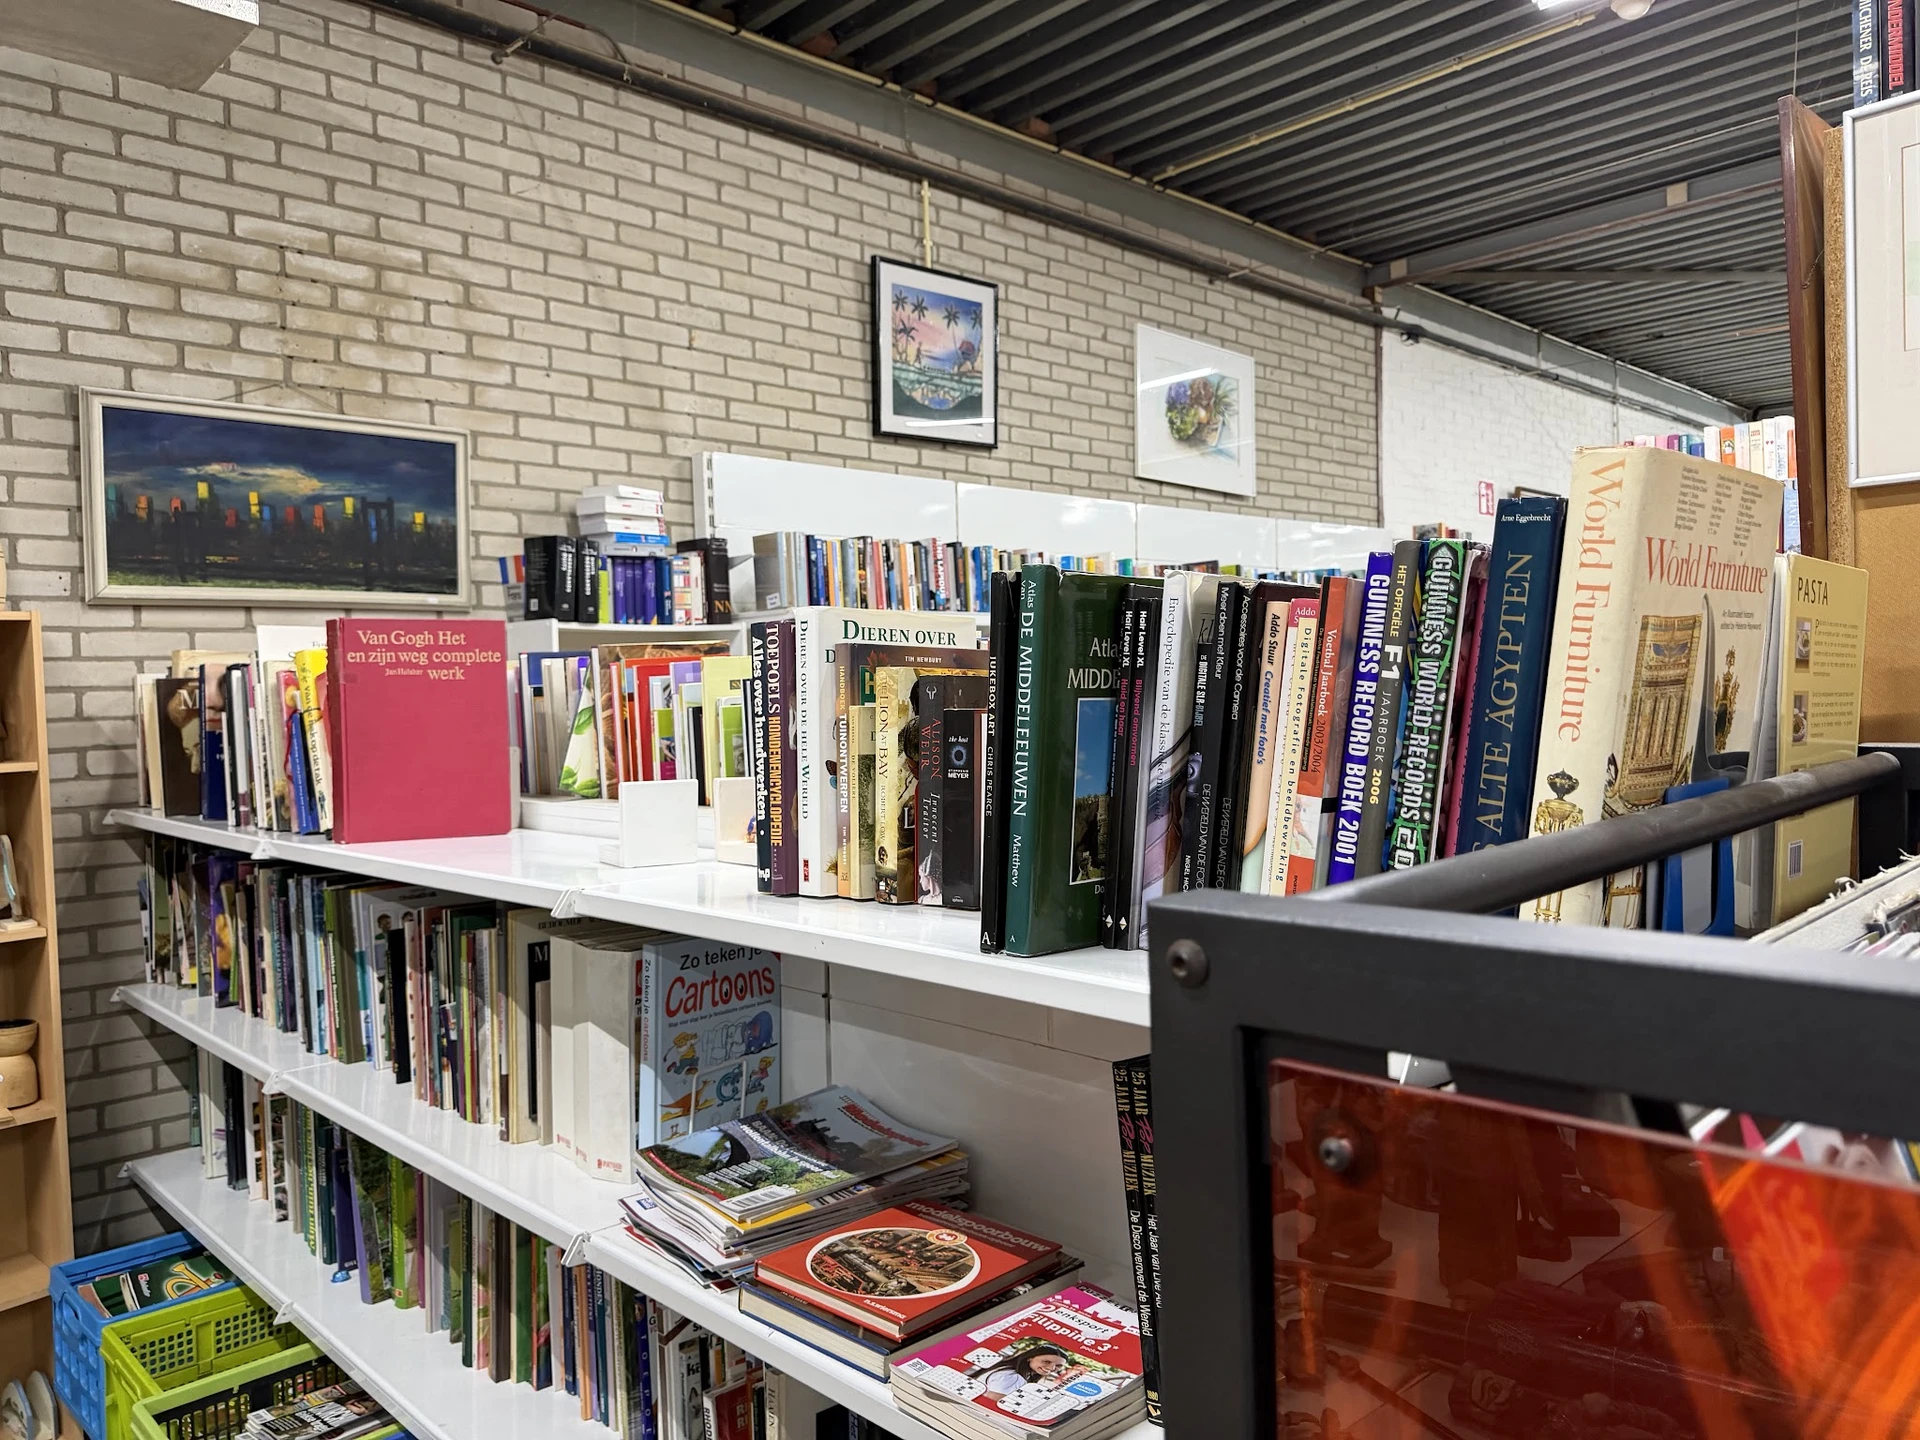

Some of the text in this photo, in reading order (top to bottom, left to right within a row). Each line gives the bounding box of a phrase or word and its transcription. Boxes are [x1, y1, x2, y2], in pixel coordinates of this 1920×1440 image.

[1887, 0, 1904, 90] NDERMIDDEL
[1860, 71, 1873, 97] REIS
[1501, 514, 1551, 524] Arne Eggebrecht
[1398, 564, 1408, 586] HET
[1645, 537, 1769, 594] World Furniture
[1027, 580, 1037, 609] Atlas
[1220, 587, 1230, 611] Meer
[1558, 458, 1626, 743] World Furniture
[1797, 576, 1829, 607] PASTA
[1218, 611, 1228, 637] doen
[1295, 607, 1316, 616] Addo
[358, 630, 466, 648] Van Gogh Het
[800, 620, 808, 669] DIEREN
[842, 619, 957, 646] DIEREN OVER
[1121, 611, 1133, 668] Hair Level XL
[1136, 611, 1147, 668] Hair Level XL
[1485, 551, 1533, 732] ÄGYPTEN
[347, 648, 502, 667] en zijn weg complete
[1231, 595, 1251, 720] Accessoires voor de Camera
[1300, 627, 1313, 681] Digitale
[1381, 644, 1404, 680] F1
[385, 668, 398, 677] Jan
[428, 666, 466, 681] werk
[800, 673, 808, 705] OVER
[1119, 679, 1128, 700] Huid
[1156, 597, 1178, 777] Encyclopedie van de klassieke
[1196, 661, 1208, 690] DIGITALE
[1256, 613, 1281, 765] Addo Stuur Creatief met foto's
[1400, 557, 1453, 821] GUINNESS WORLD RECORDS
[801, 709, 808, 727] DE
[880, 696, 889, 734] LION
[1311, 629, 1338, 774] Voetbal Jaarboek 2003/2004
[752, 636, 769, 821] Alles over handwerken
[766, 623, 783, 847] TOEPOELS HONDENENCYCLOPEDIE
[987, 713, 996, 737] ART
[1129, 679, 1143, 767] Blijvend omvormen
[1288, 687, 1306, 755] Fotografie
[1335, 574, 1391, 865] GUINNESS RECORD BOEK 2001
[839, 713, 849, 813] TUINONTWERPEN
[879, 747, 889, 779] BAY
[920, 724, 932, 771] WEIR
[931, 718, 943, 779] ALISON
[986, 746, 994, 777] CHRIS
[1011, 612, 1034, 888] DE MIDDELEEUWEN Matthew
[1369, 691, 1392, 805] JAARBOEK 2006
[1289, 760, 1297, 775] en
[801, 763, 810, 820] WERELD
[985, 779, 994, 817] PEARCE
[1475, 743, 1512, 836] ALTE
[921, 797, 932, 839] Traitor
[930, 792, 941, 843] Innocent
[1199, 796, 1210, 834] WERELD
[1219, 809, 1231, 845] WERELD
[1275, 780, 1296, 882] beeldbewerking
[1197, 834, 1207, 854] VAN
[1218, 846, 1227, 865] VAN
[1183, 854, 1191, 875] NIGEL
[1195, 868, 1205, 890] FOTO
[680, 954, 700, 971] Zo
[705, 947, 745, 966] teken
[665, 966, 775, 1018] Cartoons
[642, 958, 651, 1063] Zo teken je cartoons
[1114, 1068, 1128, 1082] 25
[1131, 1071, 1147, 1085] 25
[1116, 1084, 1130, 1113] JAAR
[1133, 1086, 1149, 1116] JAAR
[1122, 1150, 1139, 1192] MUZIEK
[1140, 1153, 1157, 1196] MUZIEK
[905, 1201, 1052, 1252] modelspoorbouw
[1129, 1209, 1141, 1224] De
[1147, 1213, 1158, 1231] Het
[1130, 1224, 1142, 1250] Disco
[1149, 1231, 1160, 1253] Jaar
[1132, 1251, 1146, 1291] verovert
[1151, 1253, 1161, 1271] van
[1137, 1290, 1148, 1303] de
[1153, 1271, 1162, 1293] Live
[1024, 1312, 1096, 1346] Filippine
[1036, 1303, 1111, 1334] Denksport
[1138, 1303, 1153, 1337] Wereld
[1079, 1345, 1103, 1356] pocket
